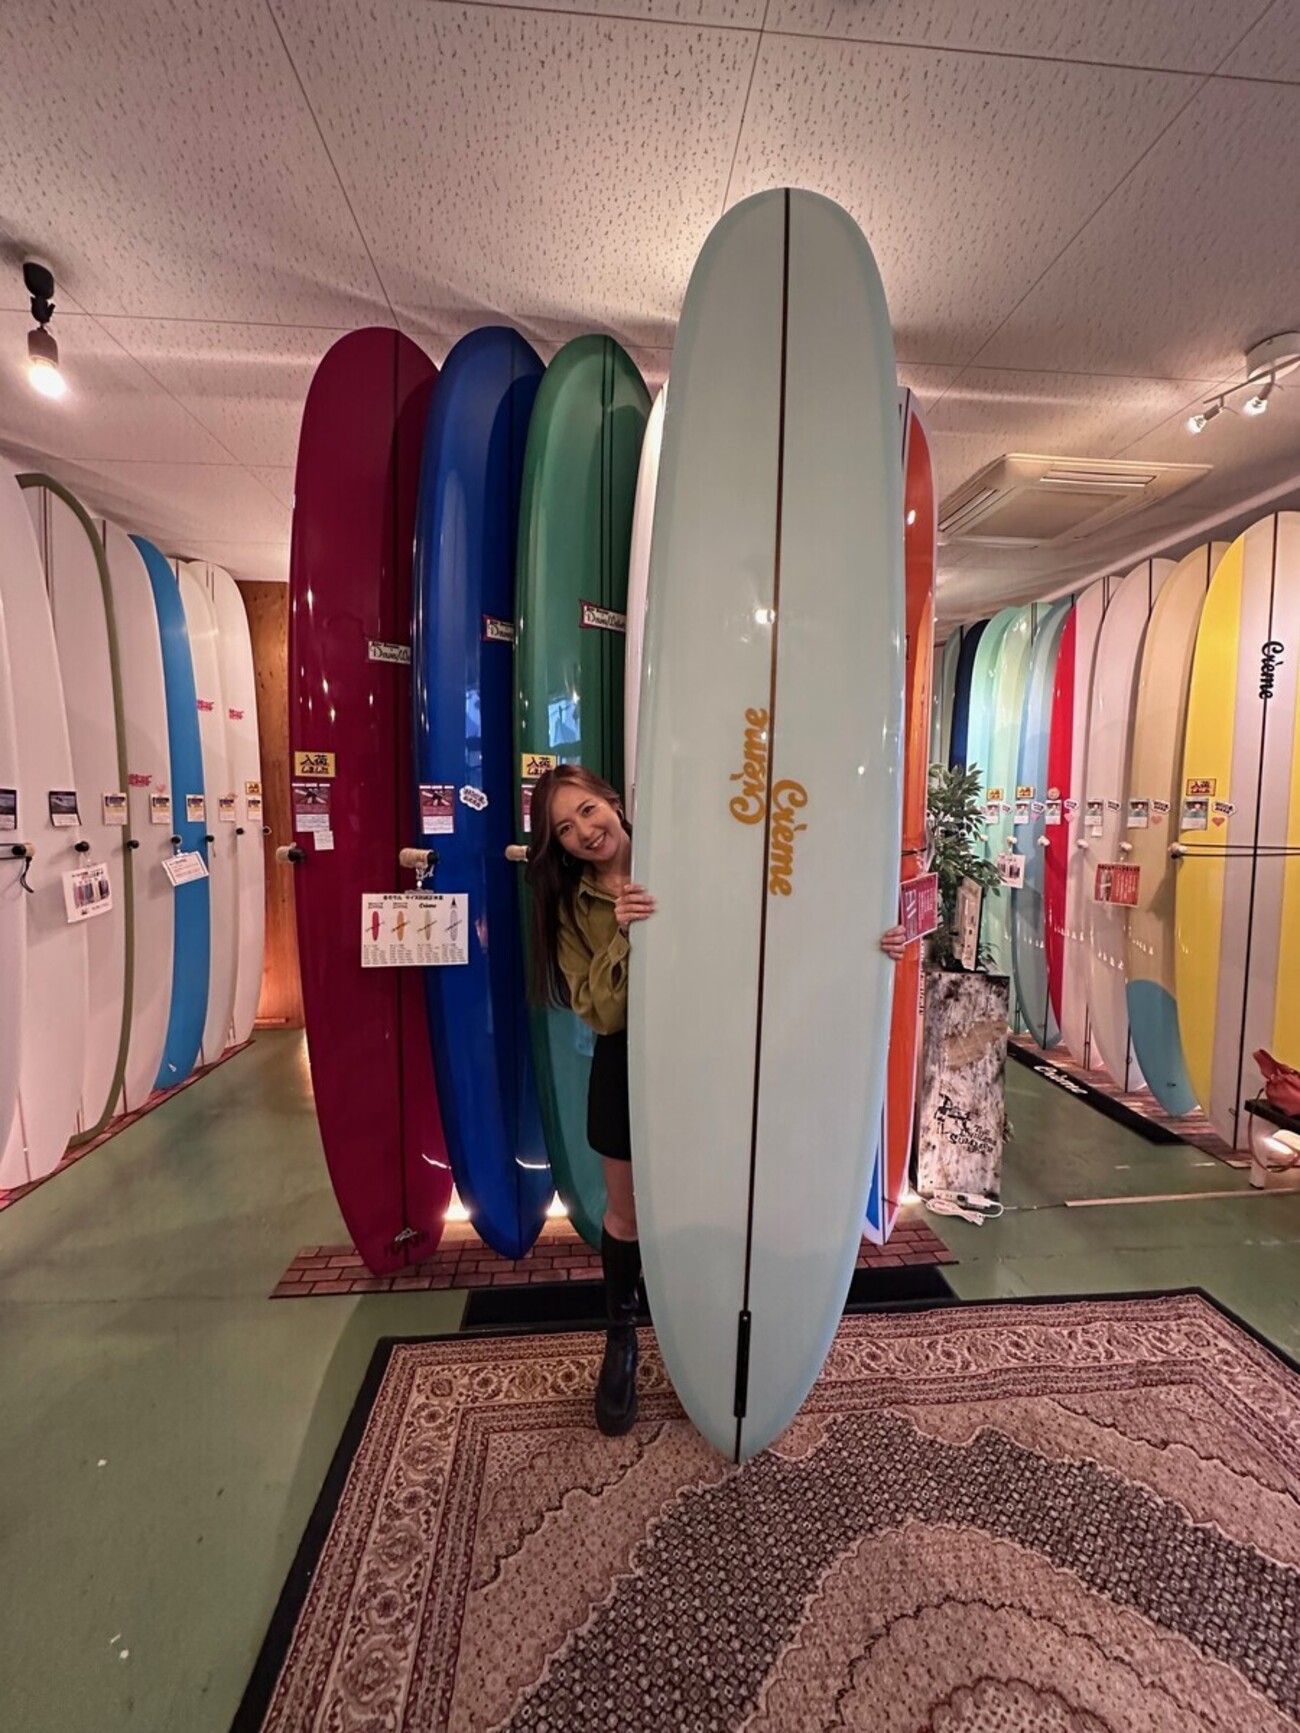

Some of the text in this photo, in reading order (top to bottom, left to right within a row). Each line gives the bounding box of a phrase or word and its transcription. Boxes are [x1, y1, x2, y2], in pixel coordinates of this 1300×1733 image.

[1259, 641, 1284, 700] Crème
[729, 708, 769, 825] Crème
[770, 779, 808, 896] Crème
